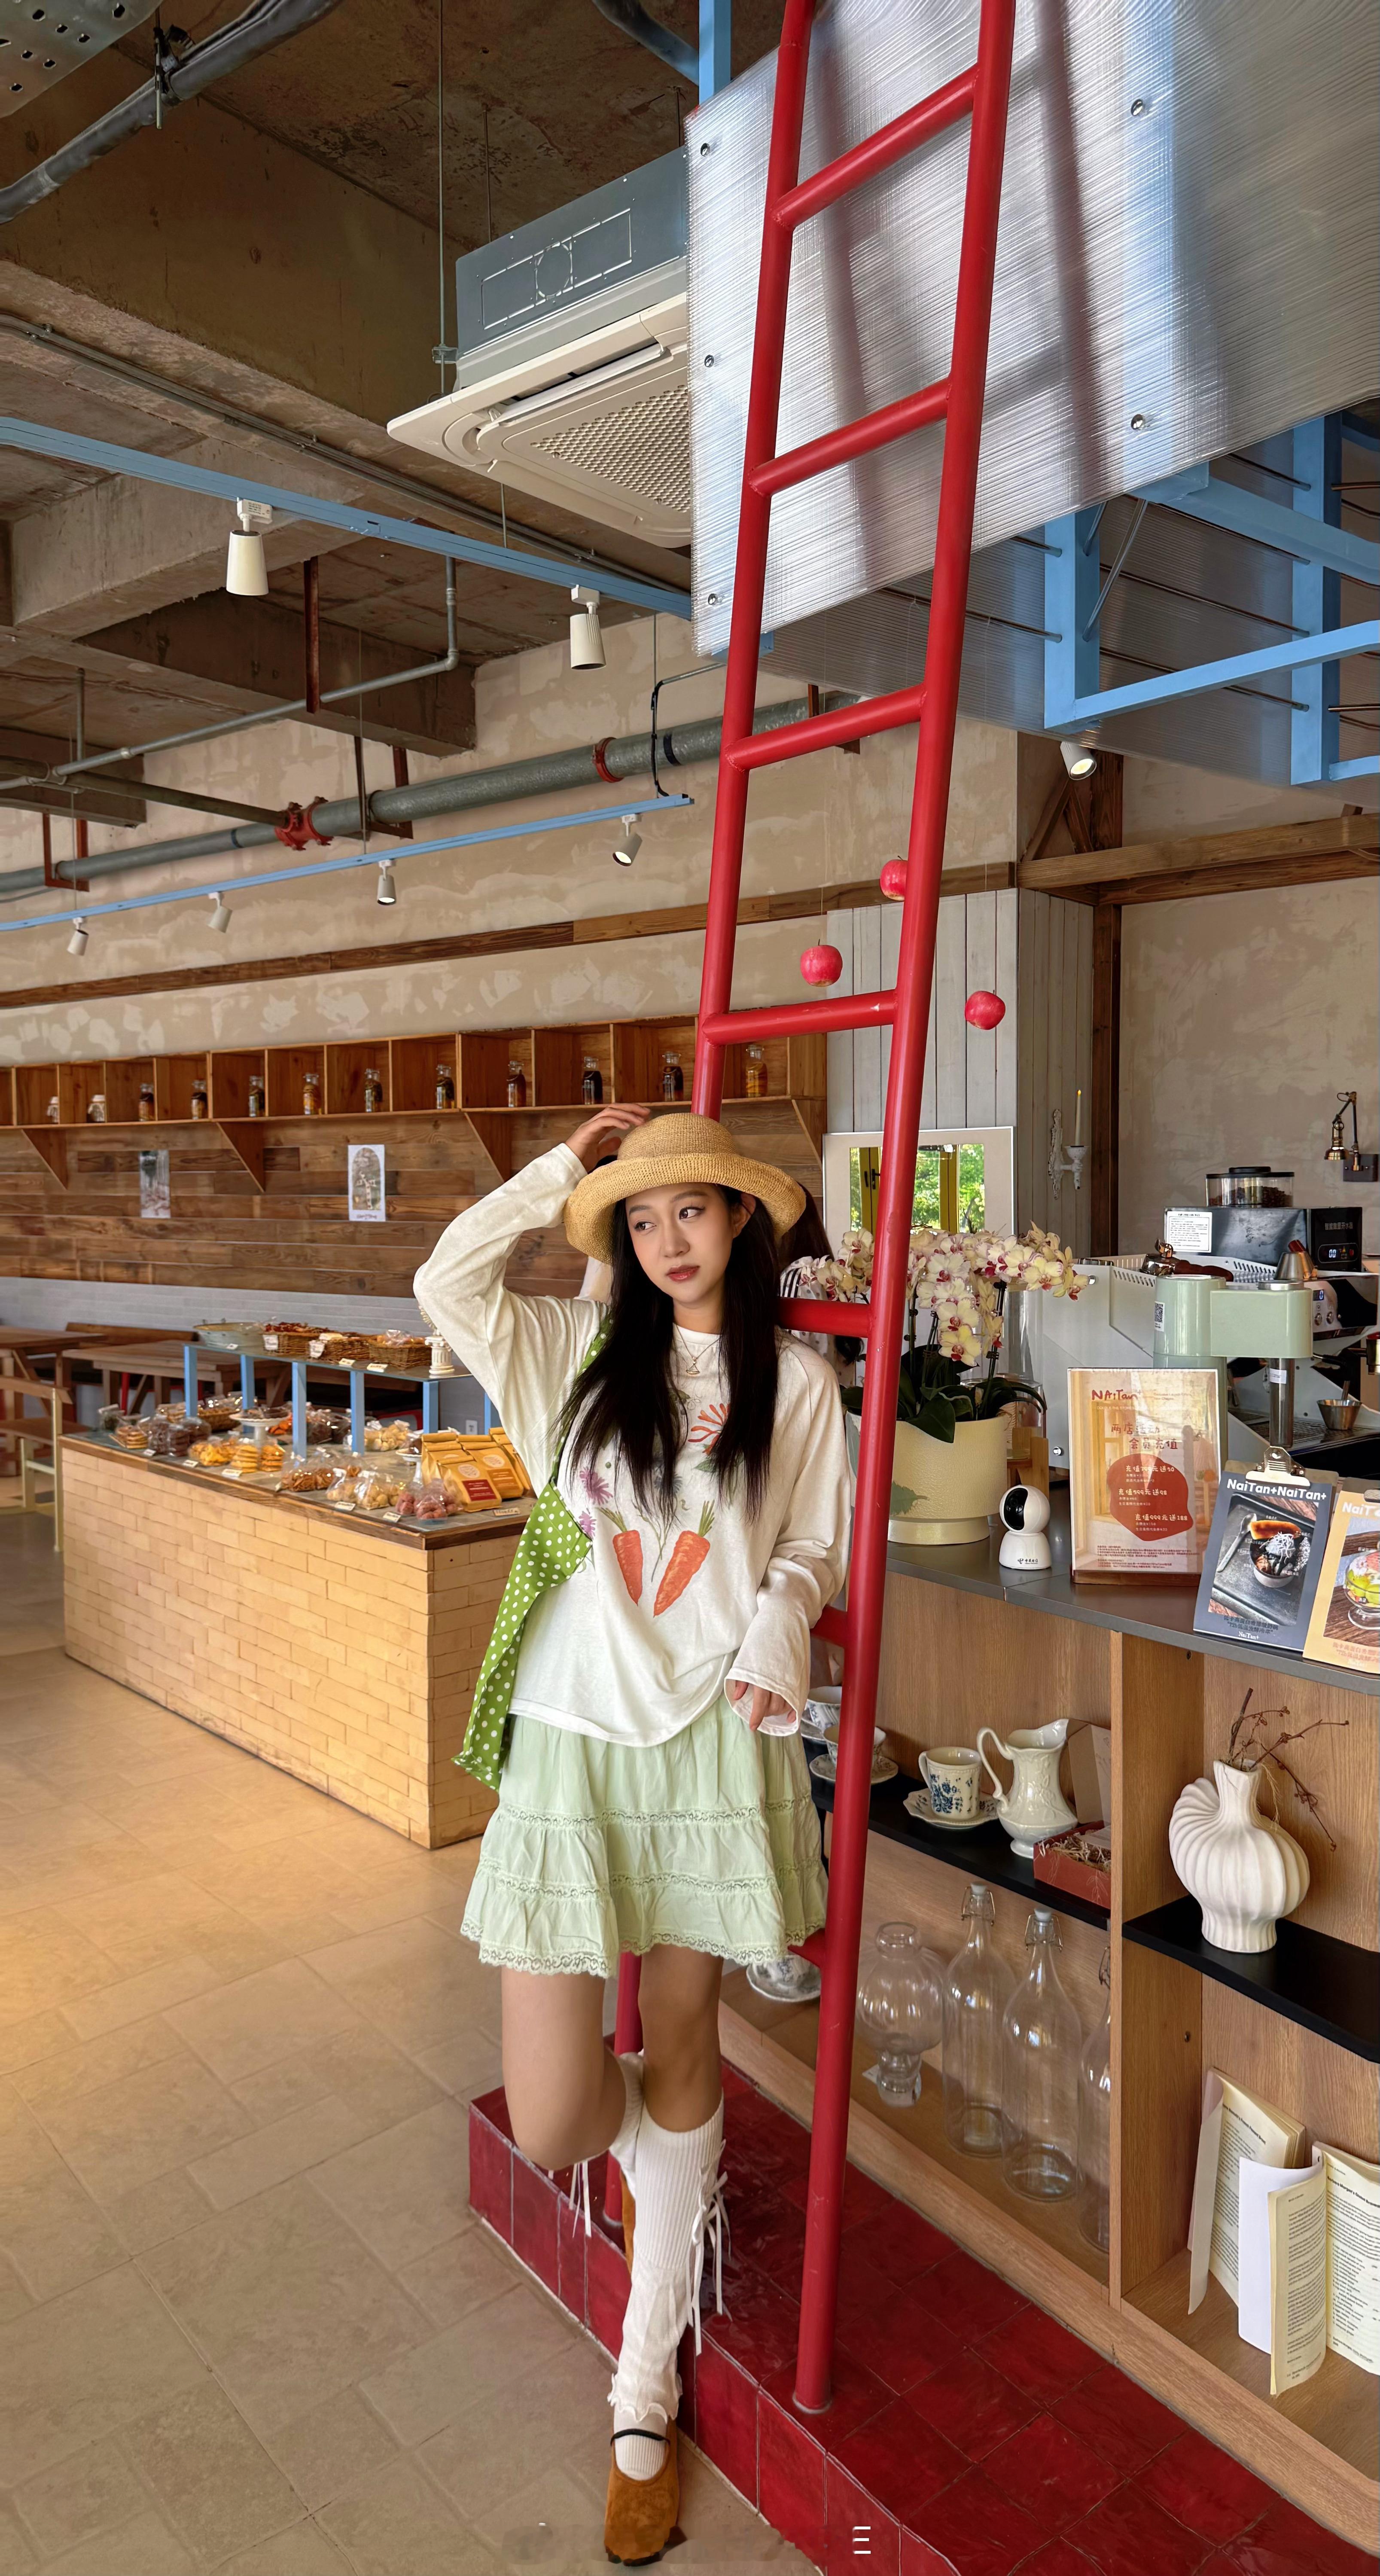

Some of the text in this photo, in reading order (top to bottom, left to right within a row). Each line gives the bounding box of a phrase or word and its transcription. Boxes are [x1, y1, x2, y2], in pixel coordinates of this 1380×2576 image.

[1328, 1249, 1336, 1258] 00
[1129, 1437, 1178, 1449] 会员充值
[1227, 1479, 1326, 1500] NaiTan+NaiTan+
